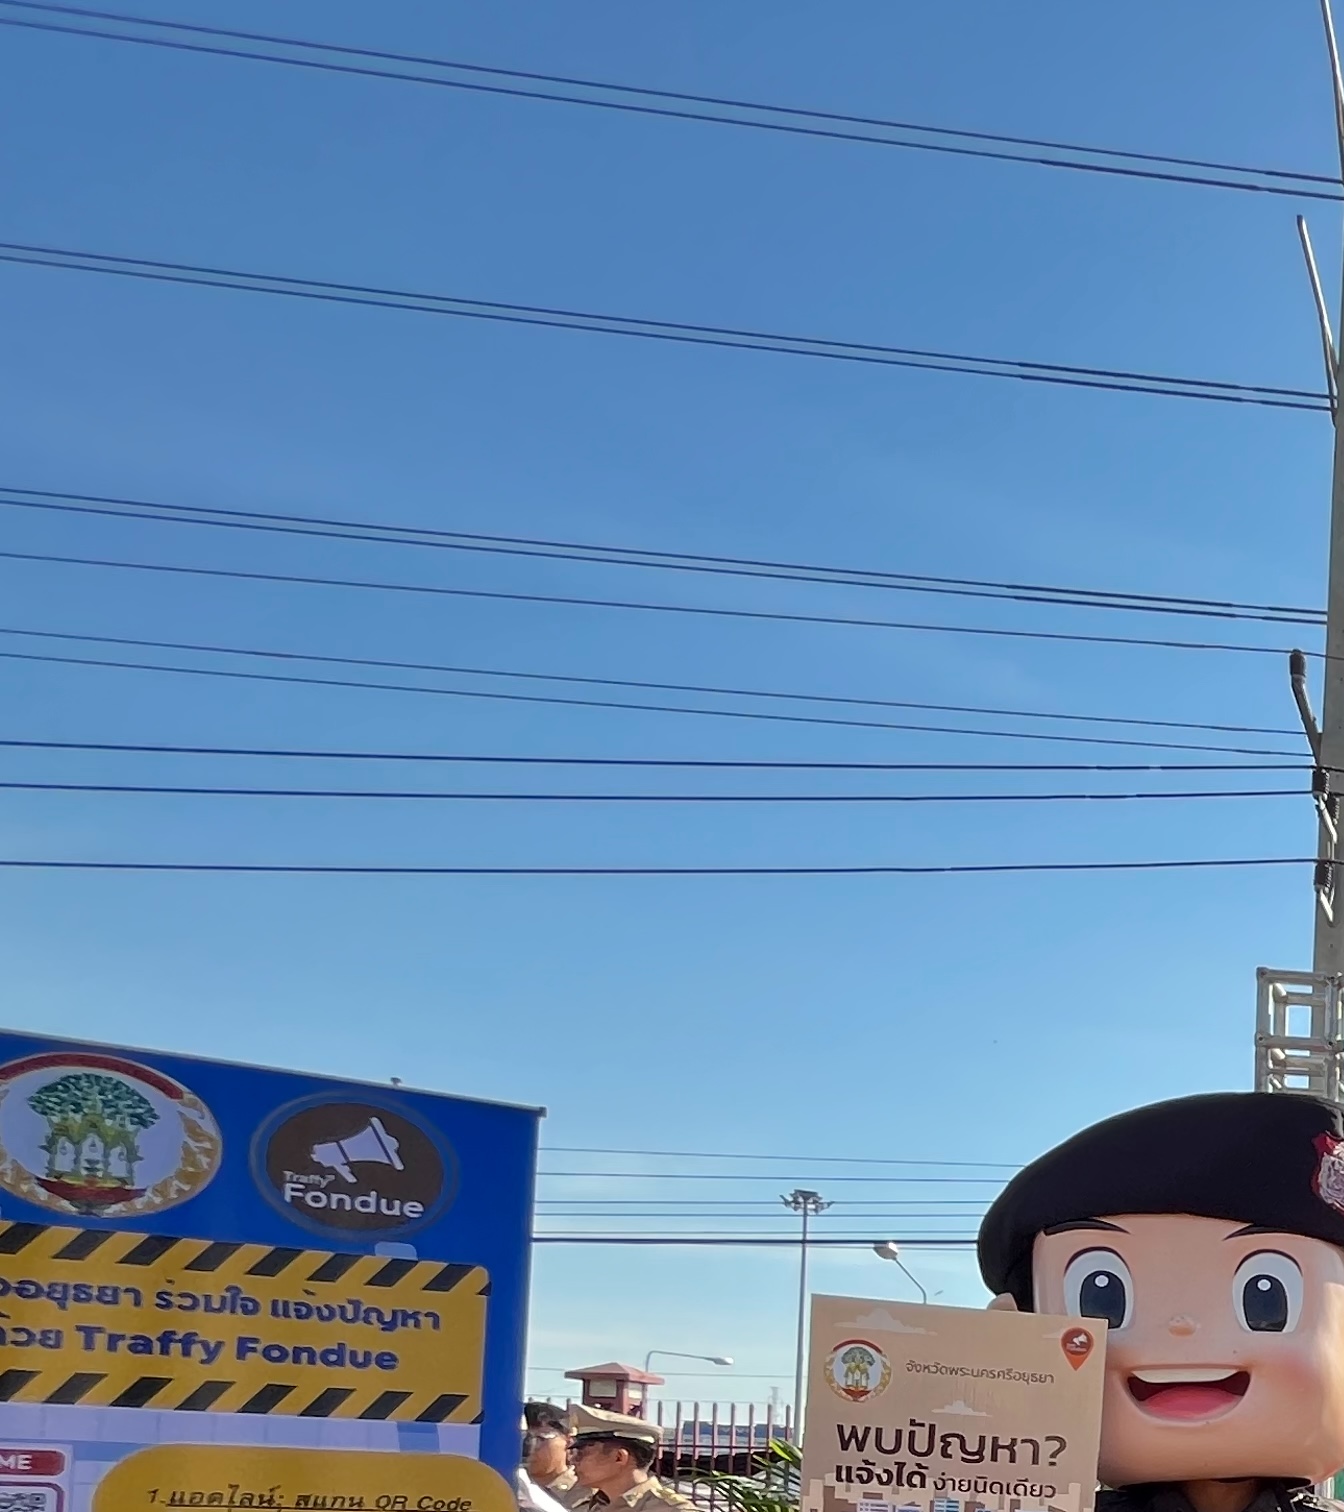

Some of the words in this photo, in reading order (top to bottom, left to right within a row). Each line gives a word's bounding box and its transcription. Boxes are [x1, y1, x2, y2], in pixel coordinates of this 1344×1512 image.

[283, 1170, 335, 1188] Traffy
[284, 1183, 424, 1218] Fondue
[155, 1278, 261, 1316] ร่วมใจ
[271, 1288, 441, 1332] แจ้งปัญหา
[75, 1325, 225, 1365] Traffy
[236, 1336, 399, 1370] Fondue
[905, 1360, 1054, 1385] จังหวัดพระนครศรีอยุธยา
[836, 1418, 1067, 1466] พบปัญหา?
[835, 1458, 929, 1488] แจ้งได้
[933, 1471, 1057, 1498] ง่ายนิดเดียว
[376, 1493, 408, 1511] QR
[417, 1494, 473, 1512] Code
